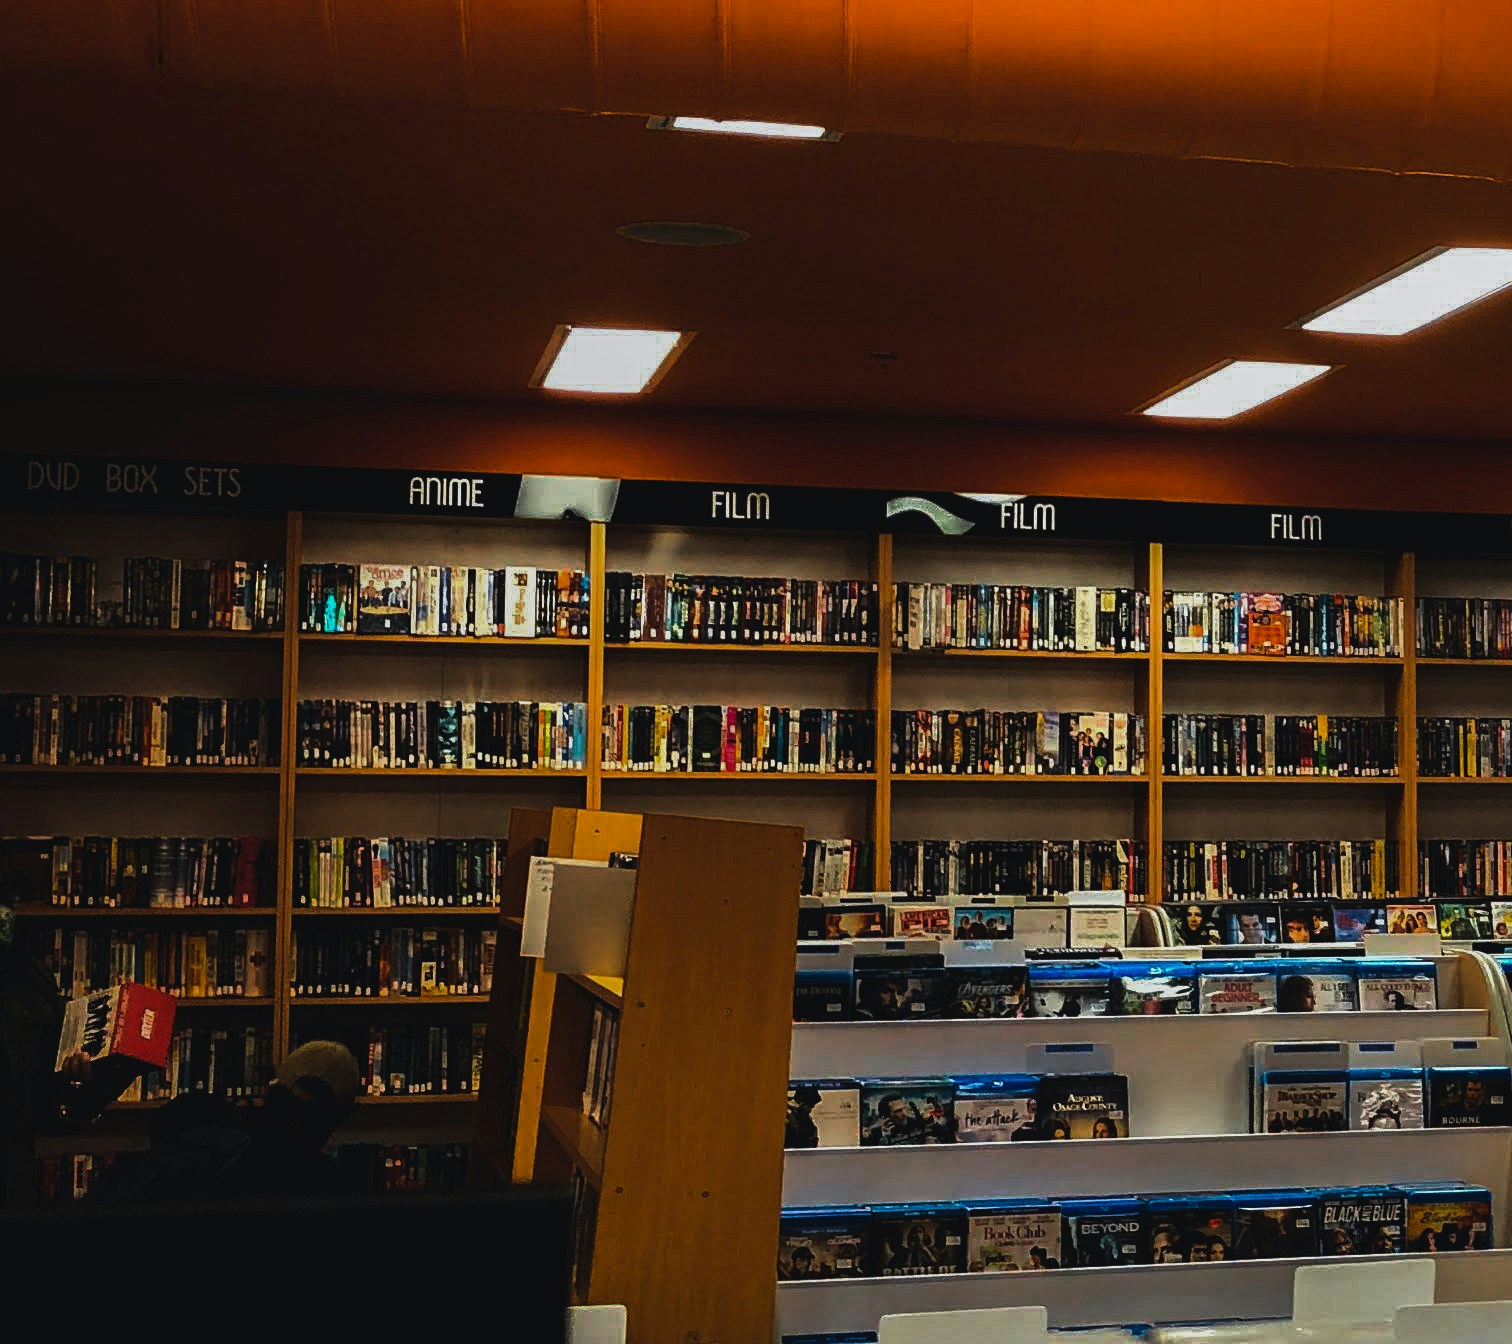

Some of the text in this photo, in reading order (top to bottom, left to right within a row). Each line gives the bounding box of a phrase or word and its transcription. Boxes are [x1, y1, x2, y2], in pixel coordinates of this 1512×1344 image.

[27, 460, 242, 498] DVD BOX SETS
[408, 477, 485, 508] ANIME
[711, 490, 771, 521] FILM
[999, 501, 1056, 531] FILM
[1269, 512, 1323, 542] FILM
[961, 982, 1013, 995] AVENGERS
[1224, 983, 1253, 992] ADULT
[965, 1110, 1021, 1127] the attack
[1442, 1115, 1481, 1125] BOURNE
[1323, 1206, 1361, 1224] BLACK
[1372, 1204, 1402, 1222] BLUE
[984, 1224, 1046, 1240] Book Club
[1081, 1222, 1139, 1235] BEYOND
